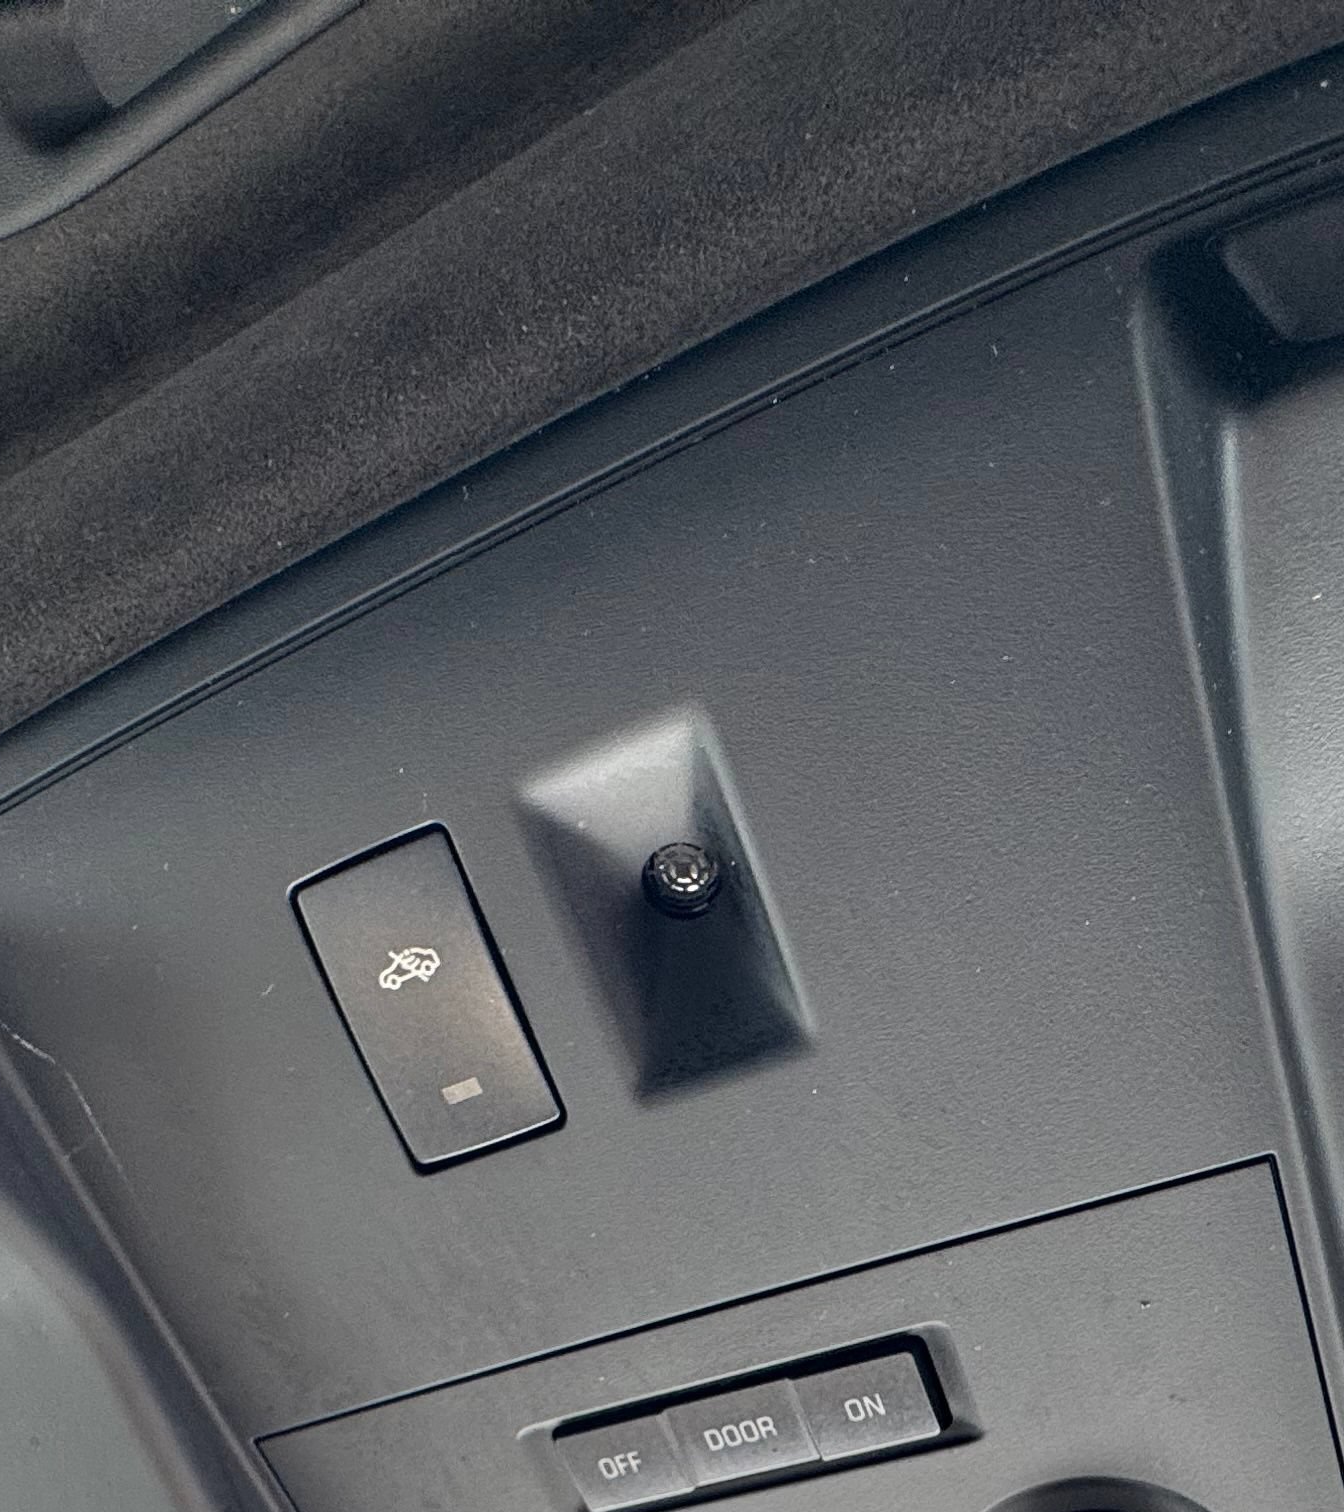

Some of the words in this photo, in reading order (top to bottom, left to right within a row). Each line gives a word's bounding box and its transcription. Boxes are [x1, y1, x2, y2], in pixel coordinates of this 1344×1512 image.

[843, 1393, 887, 1423] ON
[703, 1415, 779, 1451] DOOR
[597, 1451, 642, 1481] OFF
